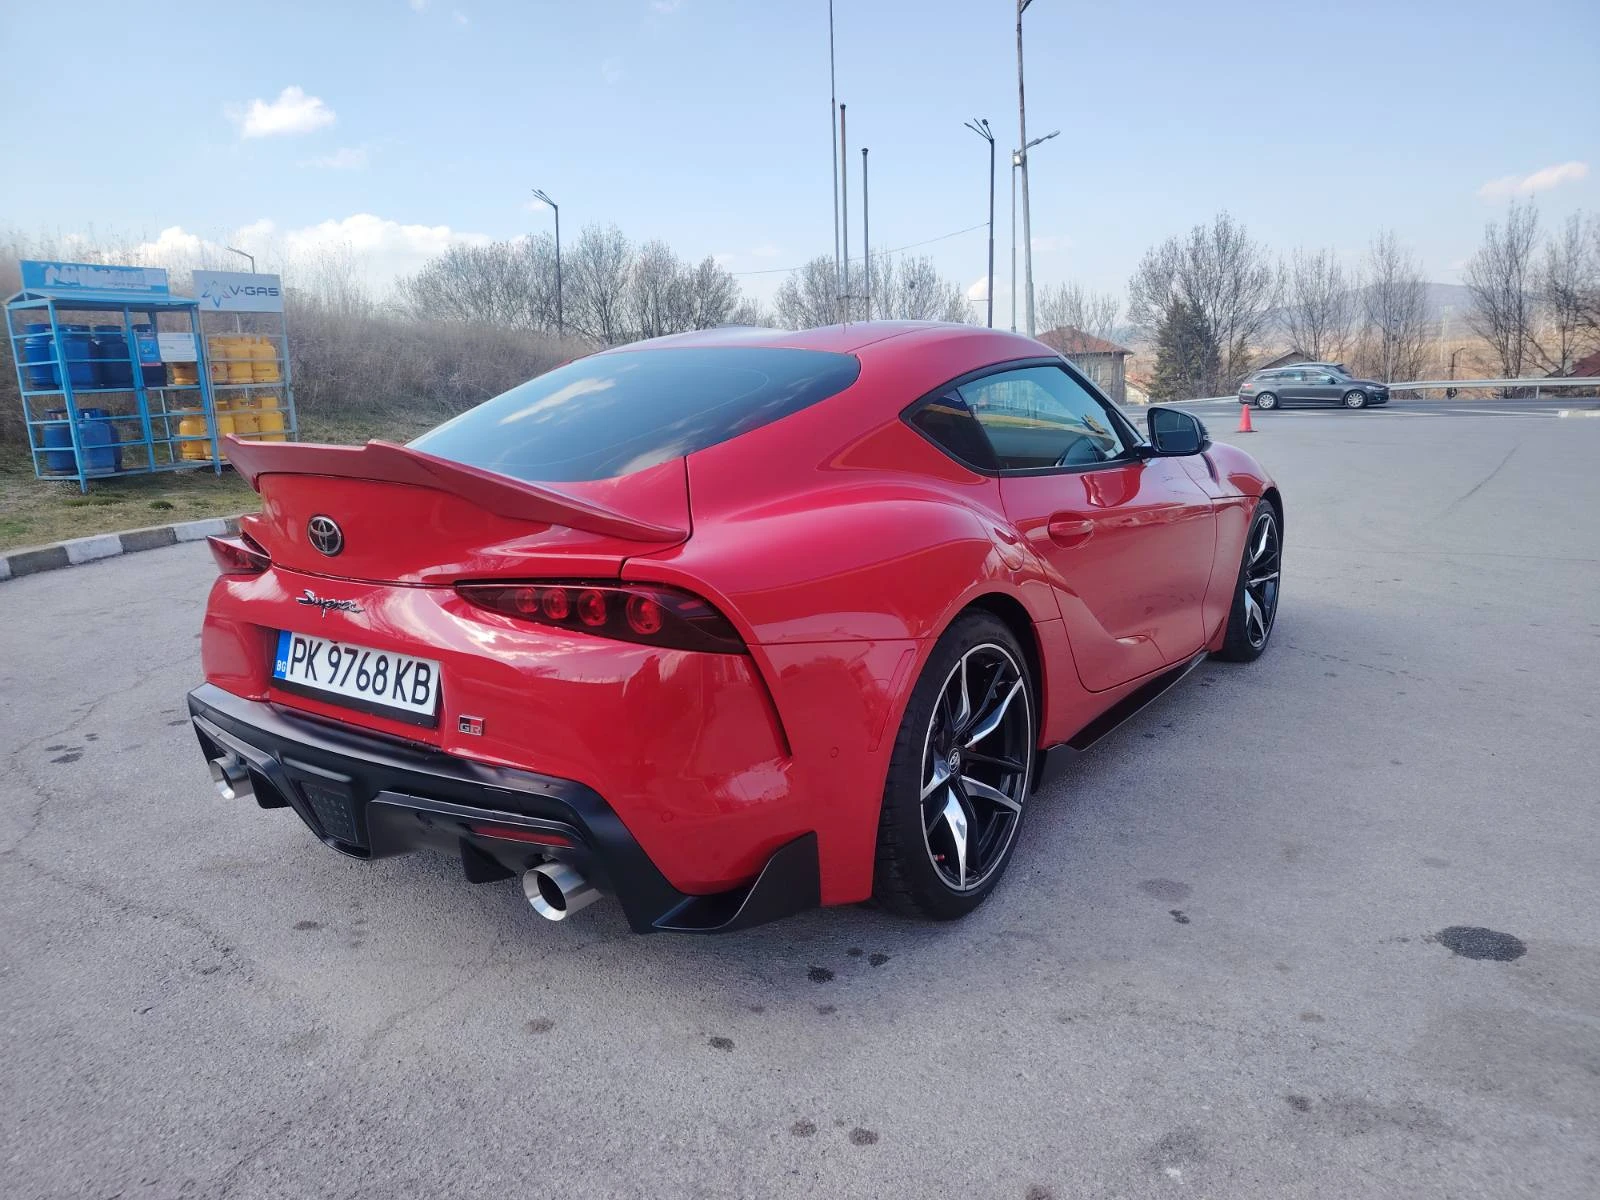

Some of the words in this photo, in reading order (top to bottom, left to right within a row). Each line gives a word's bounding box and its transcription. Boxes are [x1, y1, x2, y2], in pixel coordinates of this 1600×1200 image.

[230, 286, 279, 297] V-GAS
[296, 589, 365, 618] Supra
[276, 660, 287, 672] BG
[290, 638, 323, 681] PK
[327, 645, 389, 696] 9768
[392, 658, 431, 706] KB
[459, 722, 481, 736] GR
